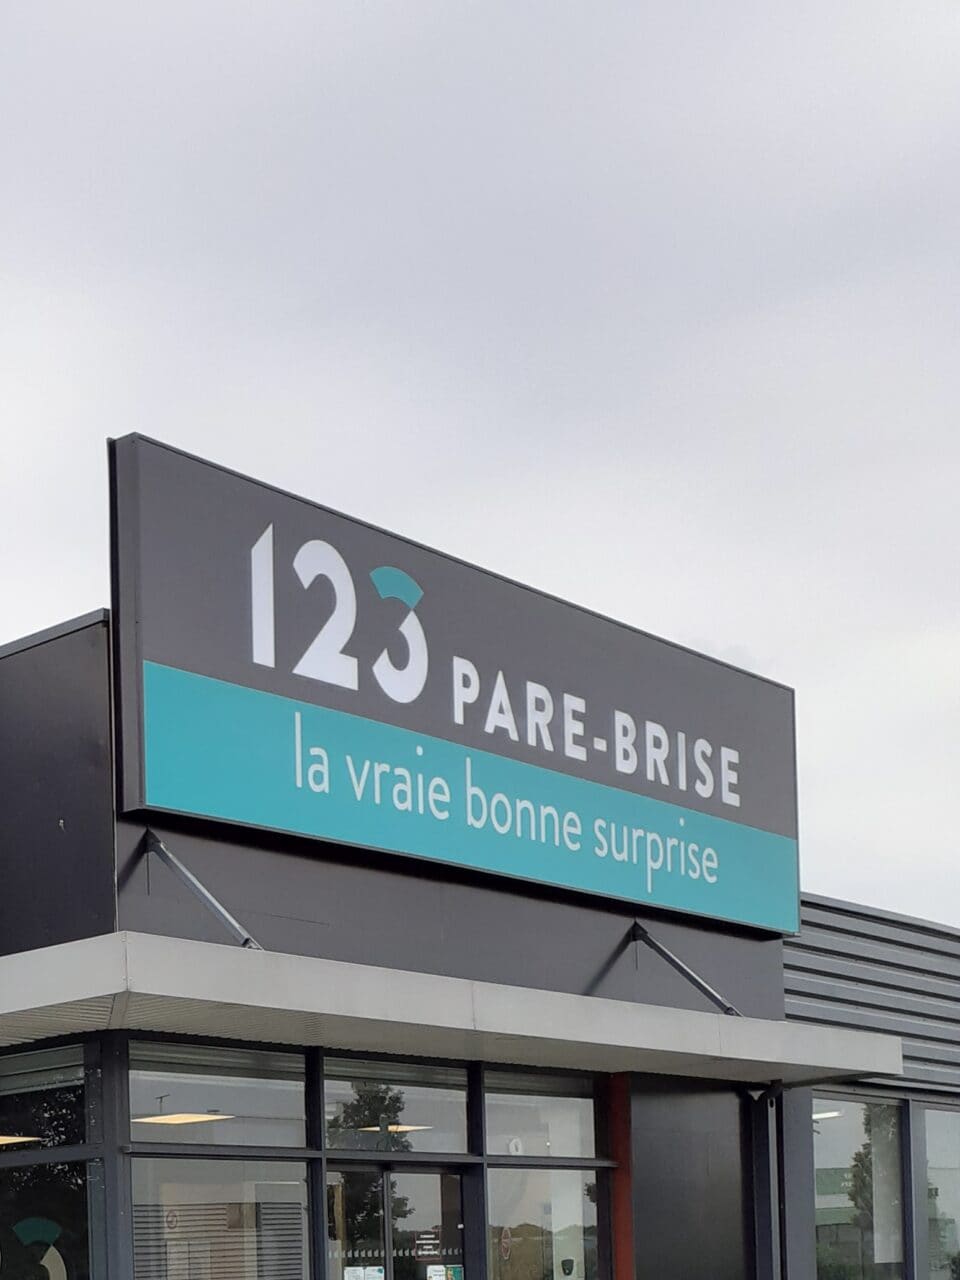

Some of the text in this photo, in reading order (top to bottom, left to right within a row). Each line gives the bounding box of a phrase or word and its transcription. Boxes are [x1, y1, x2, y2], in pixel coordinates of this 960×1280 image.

[251, 522, 741, 807] 123 PARE-BRISE
[294, 711, 719, 893] la vraie bonne surprise
